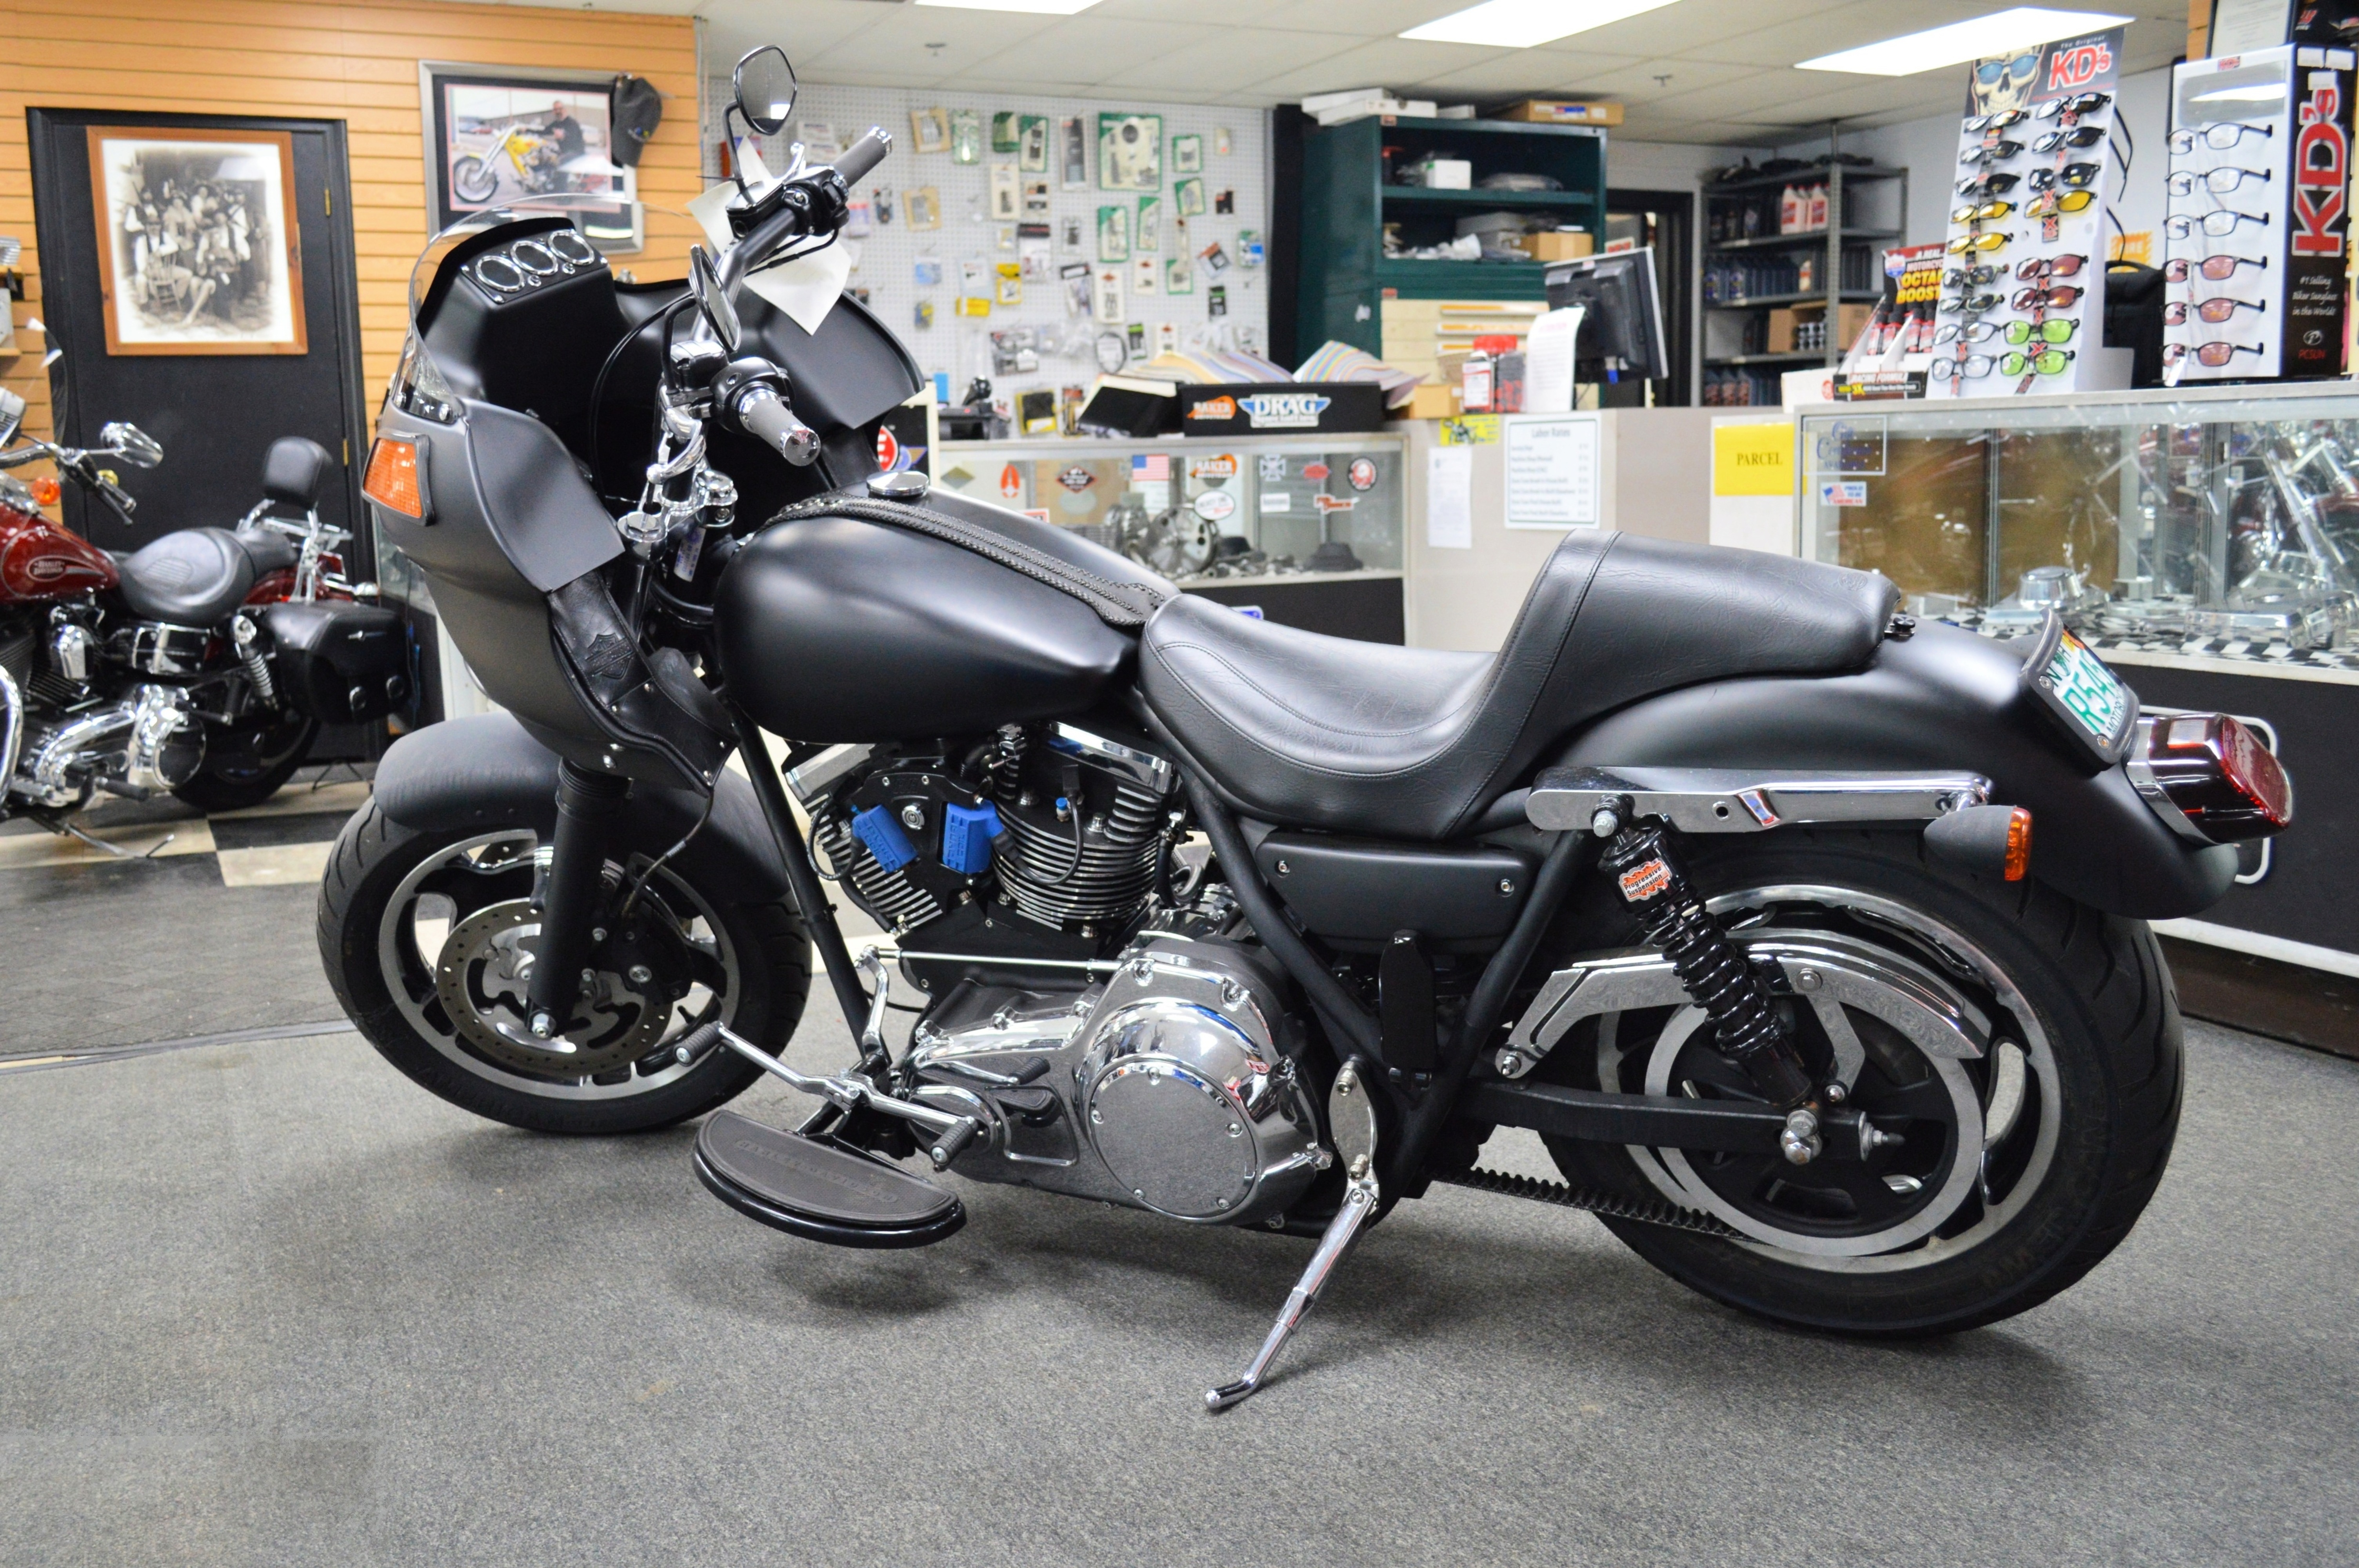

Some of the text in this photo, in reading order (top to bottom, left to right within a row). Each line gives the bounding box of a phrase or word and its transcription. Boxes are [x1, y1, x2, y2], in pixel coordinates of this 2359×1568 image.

[2048, 43, 2112, 91] KD's
[2292, 89, 2345, 256] KD's
[1255, 397, 1316, 416] DRAG
[1196, 461, 1232, 473] BAKER
[1737, 452, 1782, 465] PARCEL
[2063, 649, 2115, 733] R545
[2106, 689, 2125, 735] MOTORC
[1624, 865, 1662, 891] Progressive
[1627, 874, 1662, 896] Suspension
